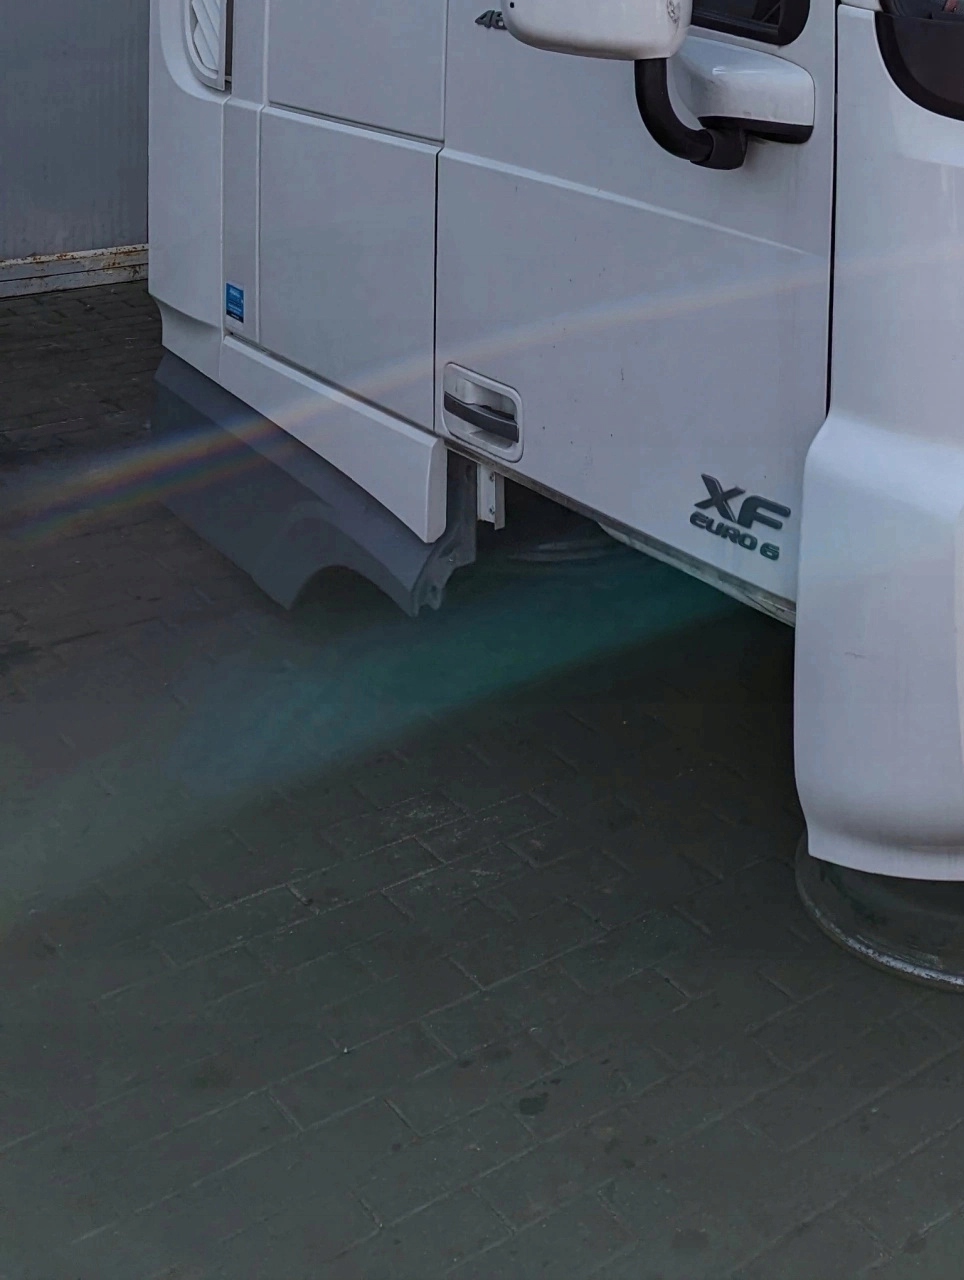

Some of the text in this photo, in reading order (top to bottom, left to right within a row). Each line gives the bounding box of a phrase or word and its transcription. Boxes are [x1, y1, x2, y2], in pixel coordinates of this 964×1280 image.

[694, 473, 791, 529] XF
[689, 511, 780, 561] EURO 6
